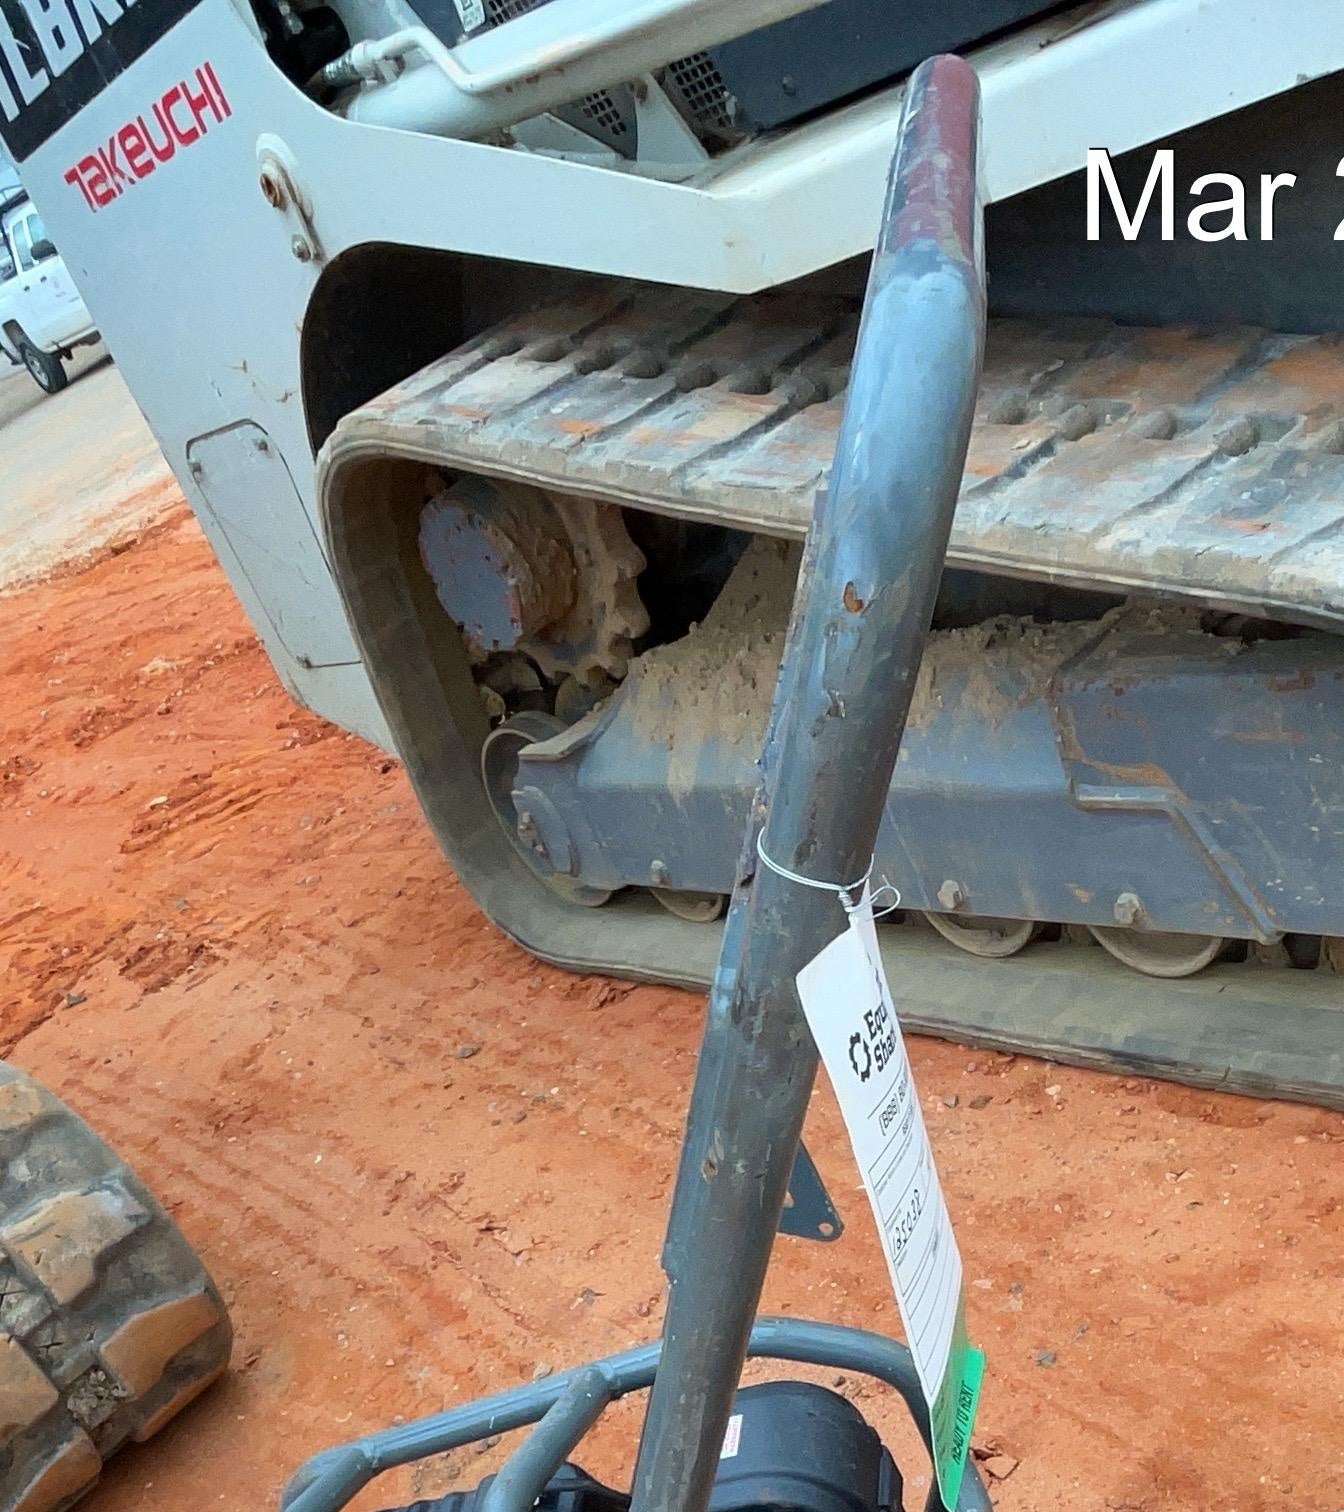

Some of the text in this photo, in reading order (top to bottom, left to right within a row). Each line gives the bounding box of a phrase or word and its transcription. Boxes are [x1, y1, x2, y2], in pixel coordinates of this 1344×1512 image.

[952, 1380, 975, 1466] READY TO RENT
